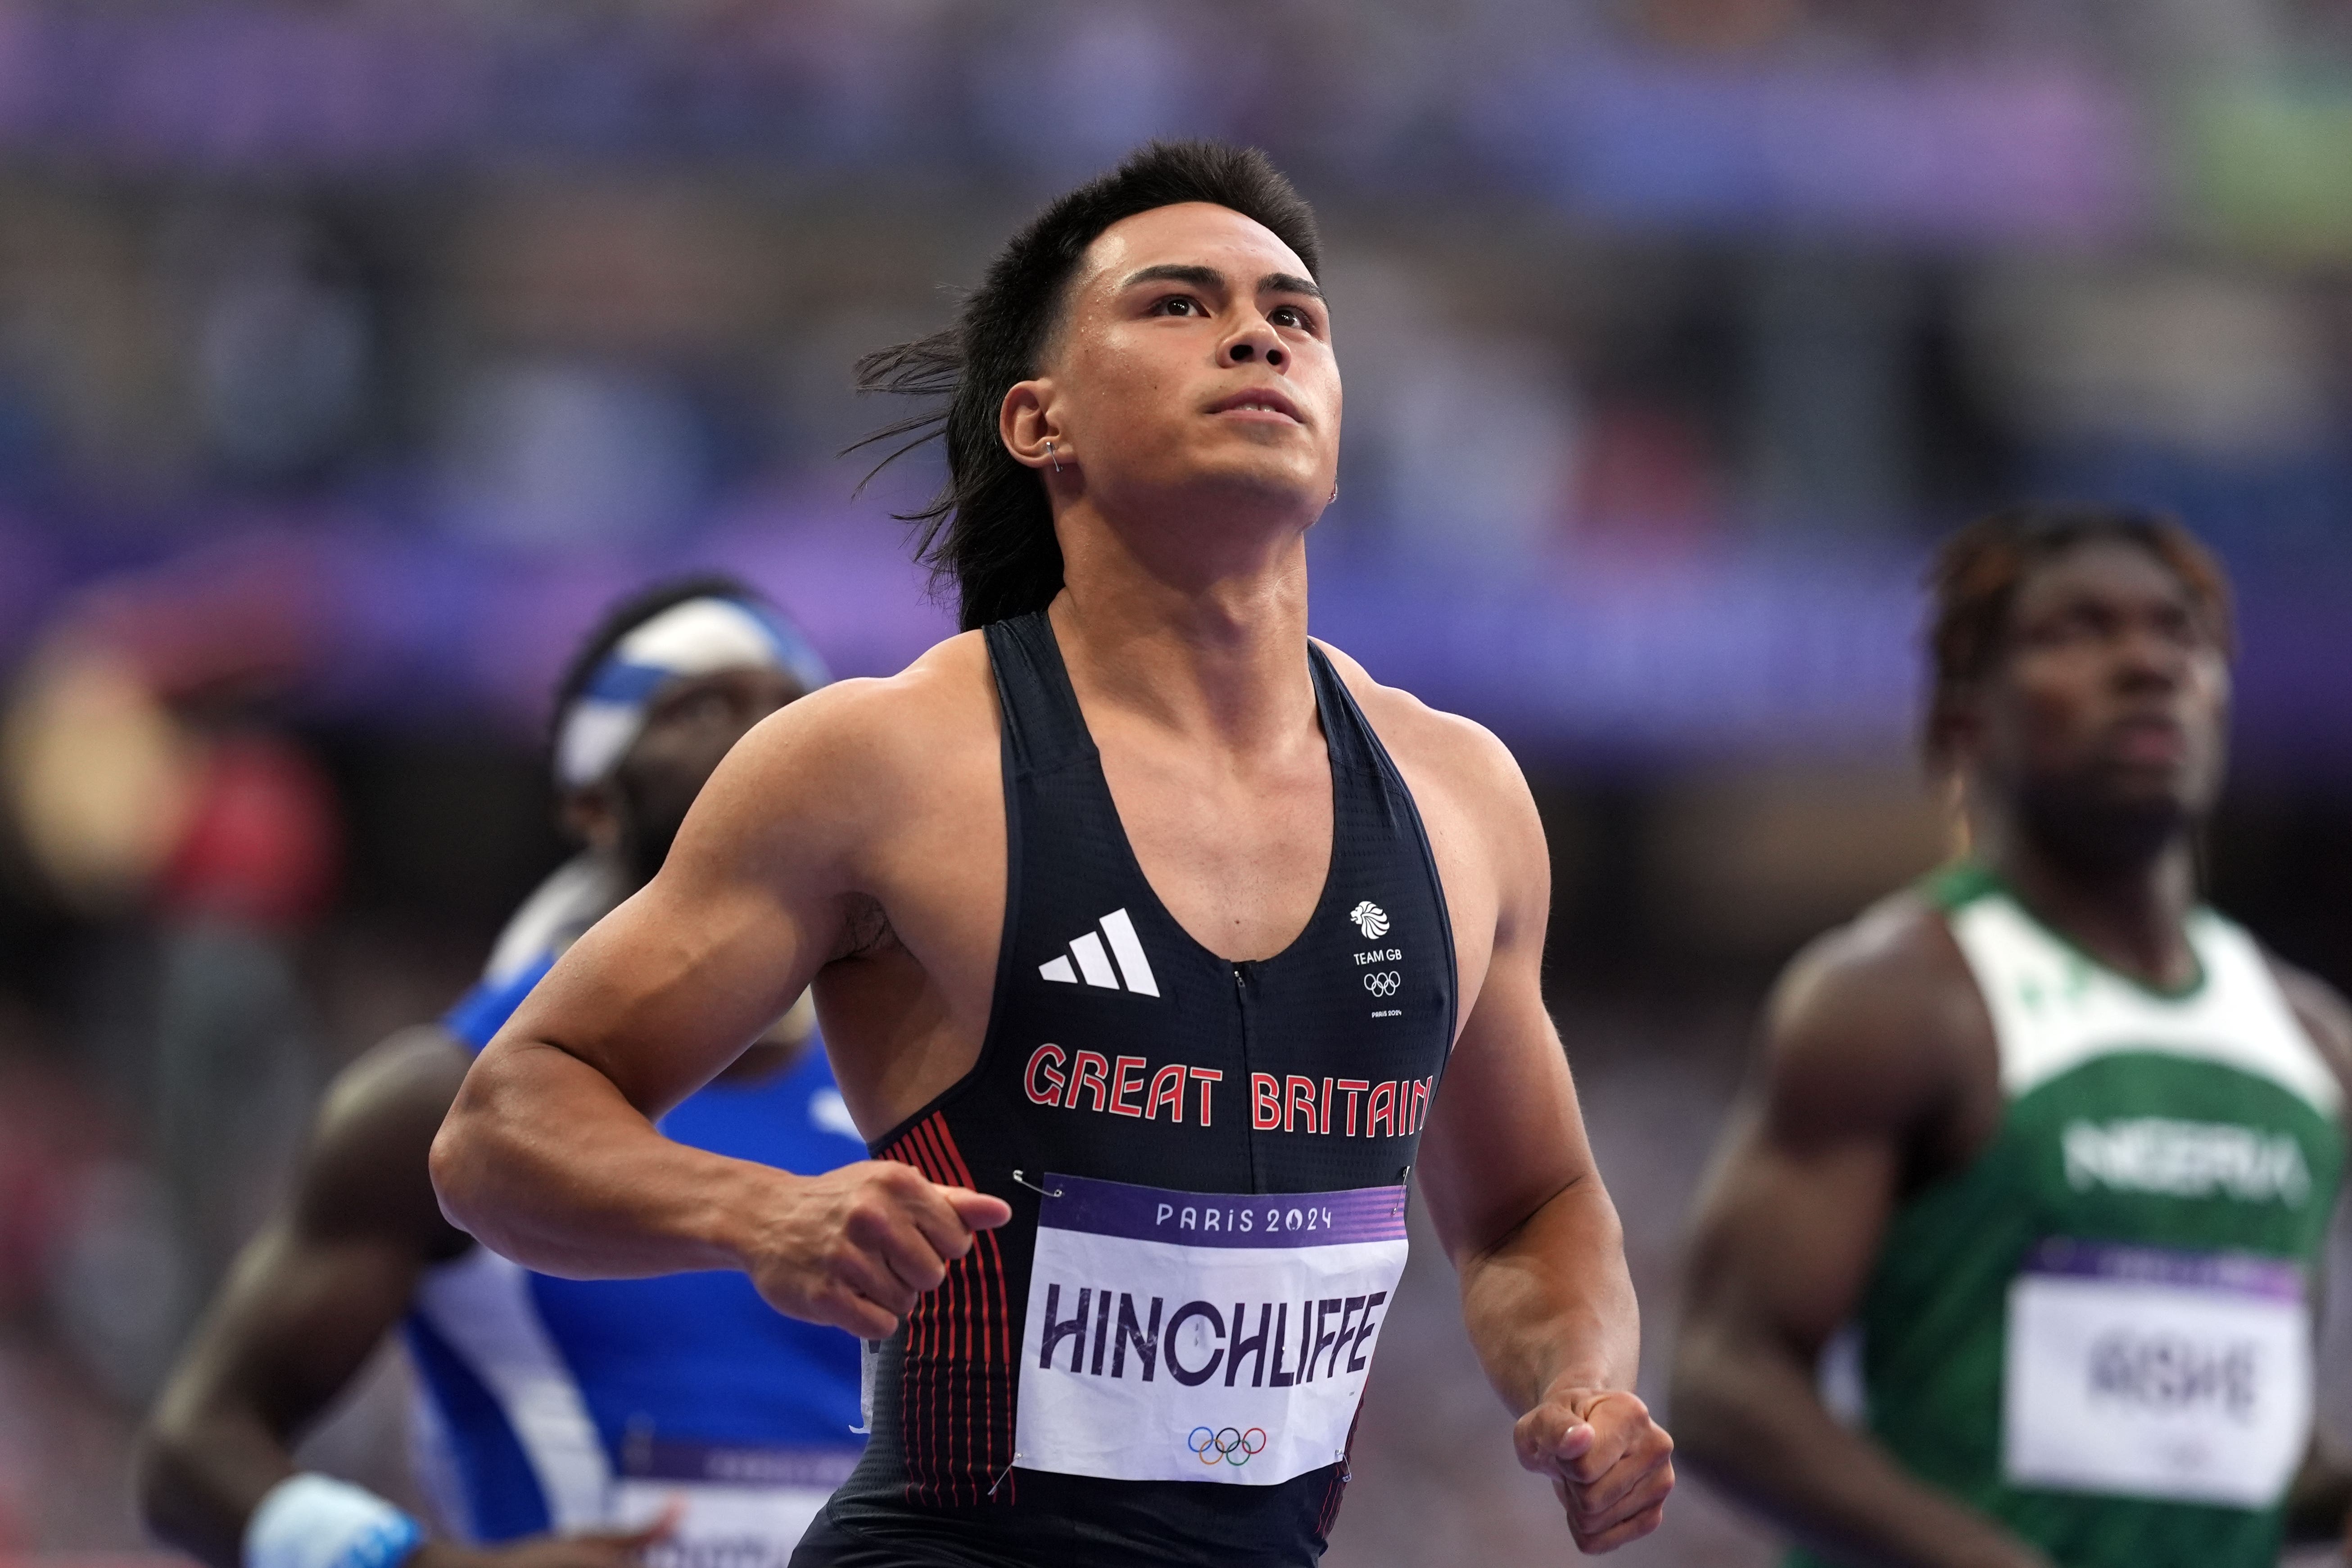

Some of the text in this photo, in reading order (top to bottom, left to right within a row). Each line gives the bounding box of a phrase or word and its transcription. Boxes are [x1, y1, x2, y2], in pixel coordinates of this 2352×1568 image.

[1353, 949, 1402, 965] TEAM GB
[1024, 1043, 1433, 1138] GREAT BRITAIN
[1266, 1207, 1331, 1232] 2024
[1039, 1283, 1388, 1388] HINCHLIFFE
